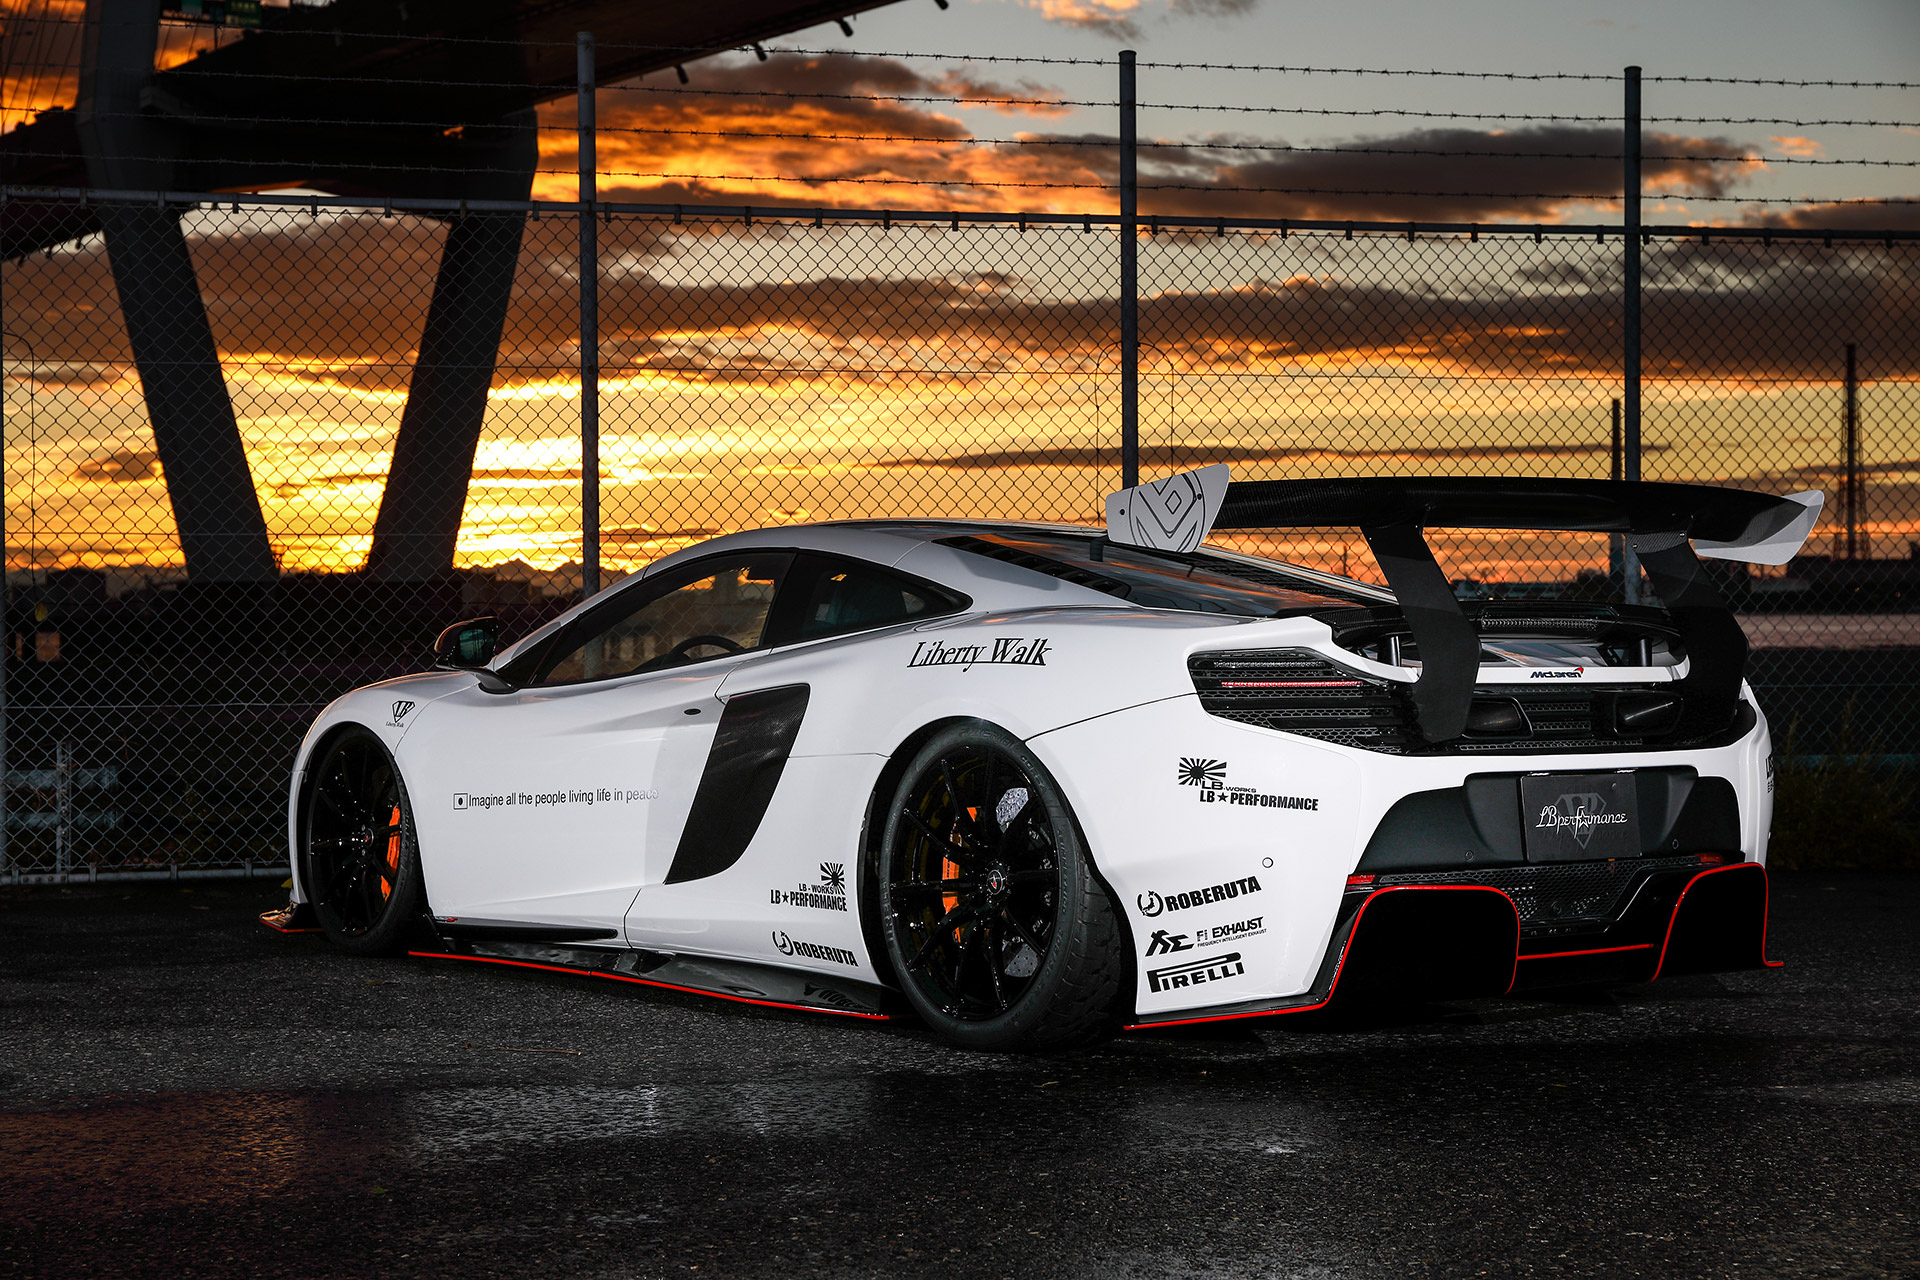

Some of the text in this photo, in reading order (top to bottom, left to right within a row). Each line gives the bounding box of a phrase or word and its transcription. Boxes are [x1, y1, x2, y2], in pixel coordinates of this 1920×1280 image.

[907, 638, 1053, 672] Liberty Walk
[1530, 670, 1582, 679] McLaren
[1201, 780, 1224, 791] LB
[469, 788, 659, 809] Imagine all the people living life in peace
[1200, 790, 1319, 811] LB PERFORMANCE
[790, 891, 848, 912] PERFORMANCE
[1164, 876, 1262, 912] ROBERUTA
[1212, 916, 1264, 938] EXHAUST
[793, 940, 859, 967] ROBERUTA
[1146, 952, 1245, 993] PIRELLI
